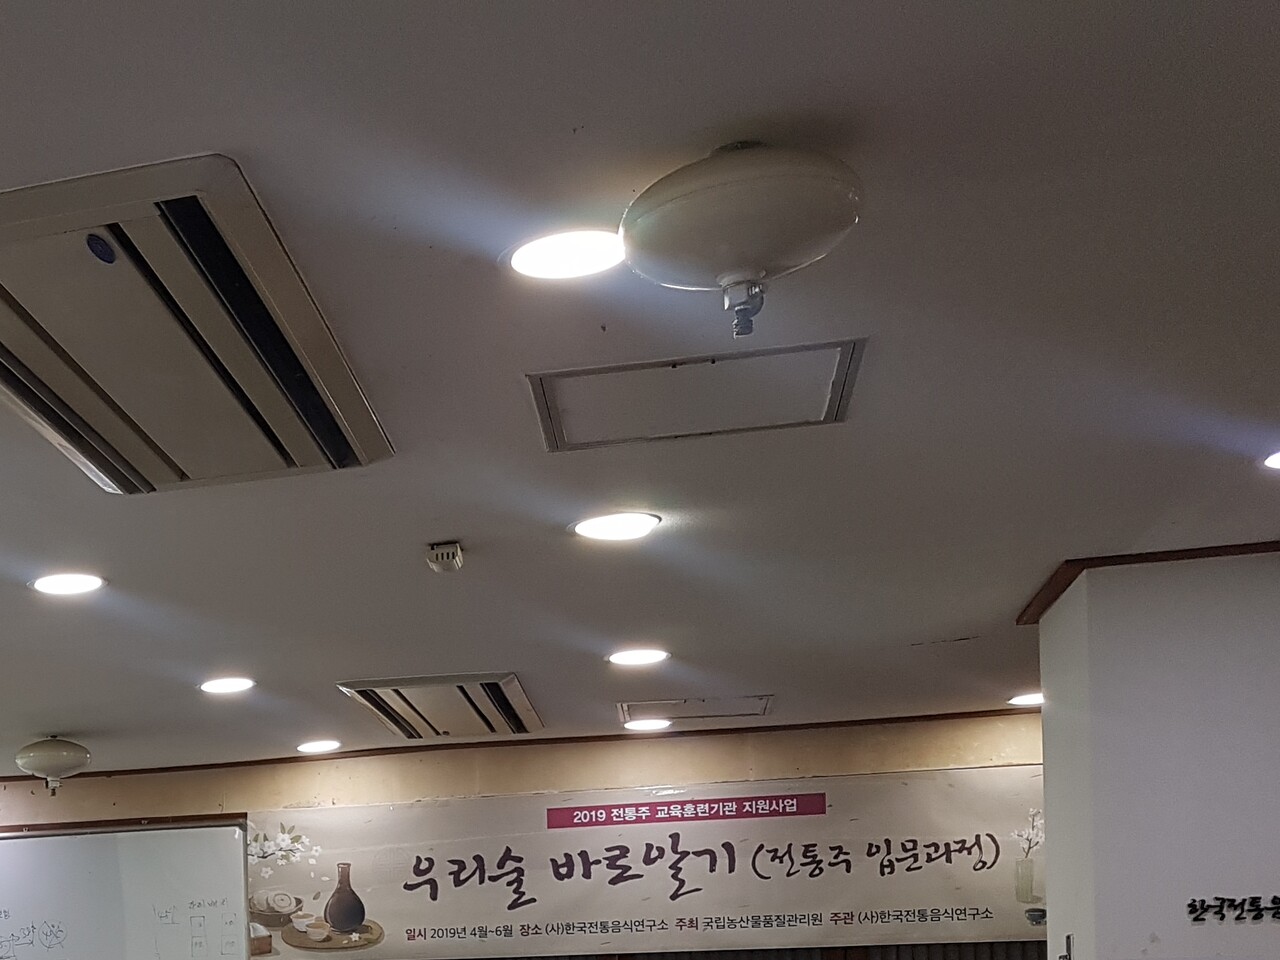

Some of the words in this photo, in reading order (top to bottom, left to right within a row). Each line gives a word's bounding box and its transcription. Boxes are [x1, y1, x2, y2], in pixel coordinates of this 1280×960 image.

[573, 810, 606, 824] 2019
[610, 806, 651, 822] 전통주
[655, 800, 737, 819] 교육훈련기관
[742, 798, 797, 815] 지원사업
[403, 845, 537, 911] 우리술
[549, 831, 736, 901] 바로알기
[405, 928, 427, 941] 일시
[430, 926, 467, 940] 2019년
[519, 923, 542, 936] 장소
[675, 917, 699, 932] 주최
[702, 912, 823, 931] 국립농산물품질관리원
[829, 911, 854, 926] 주관
